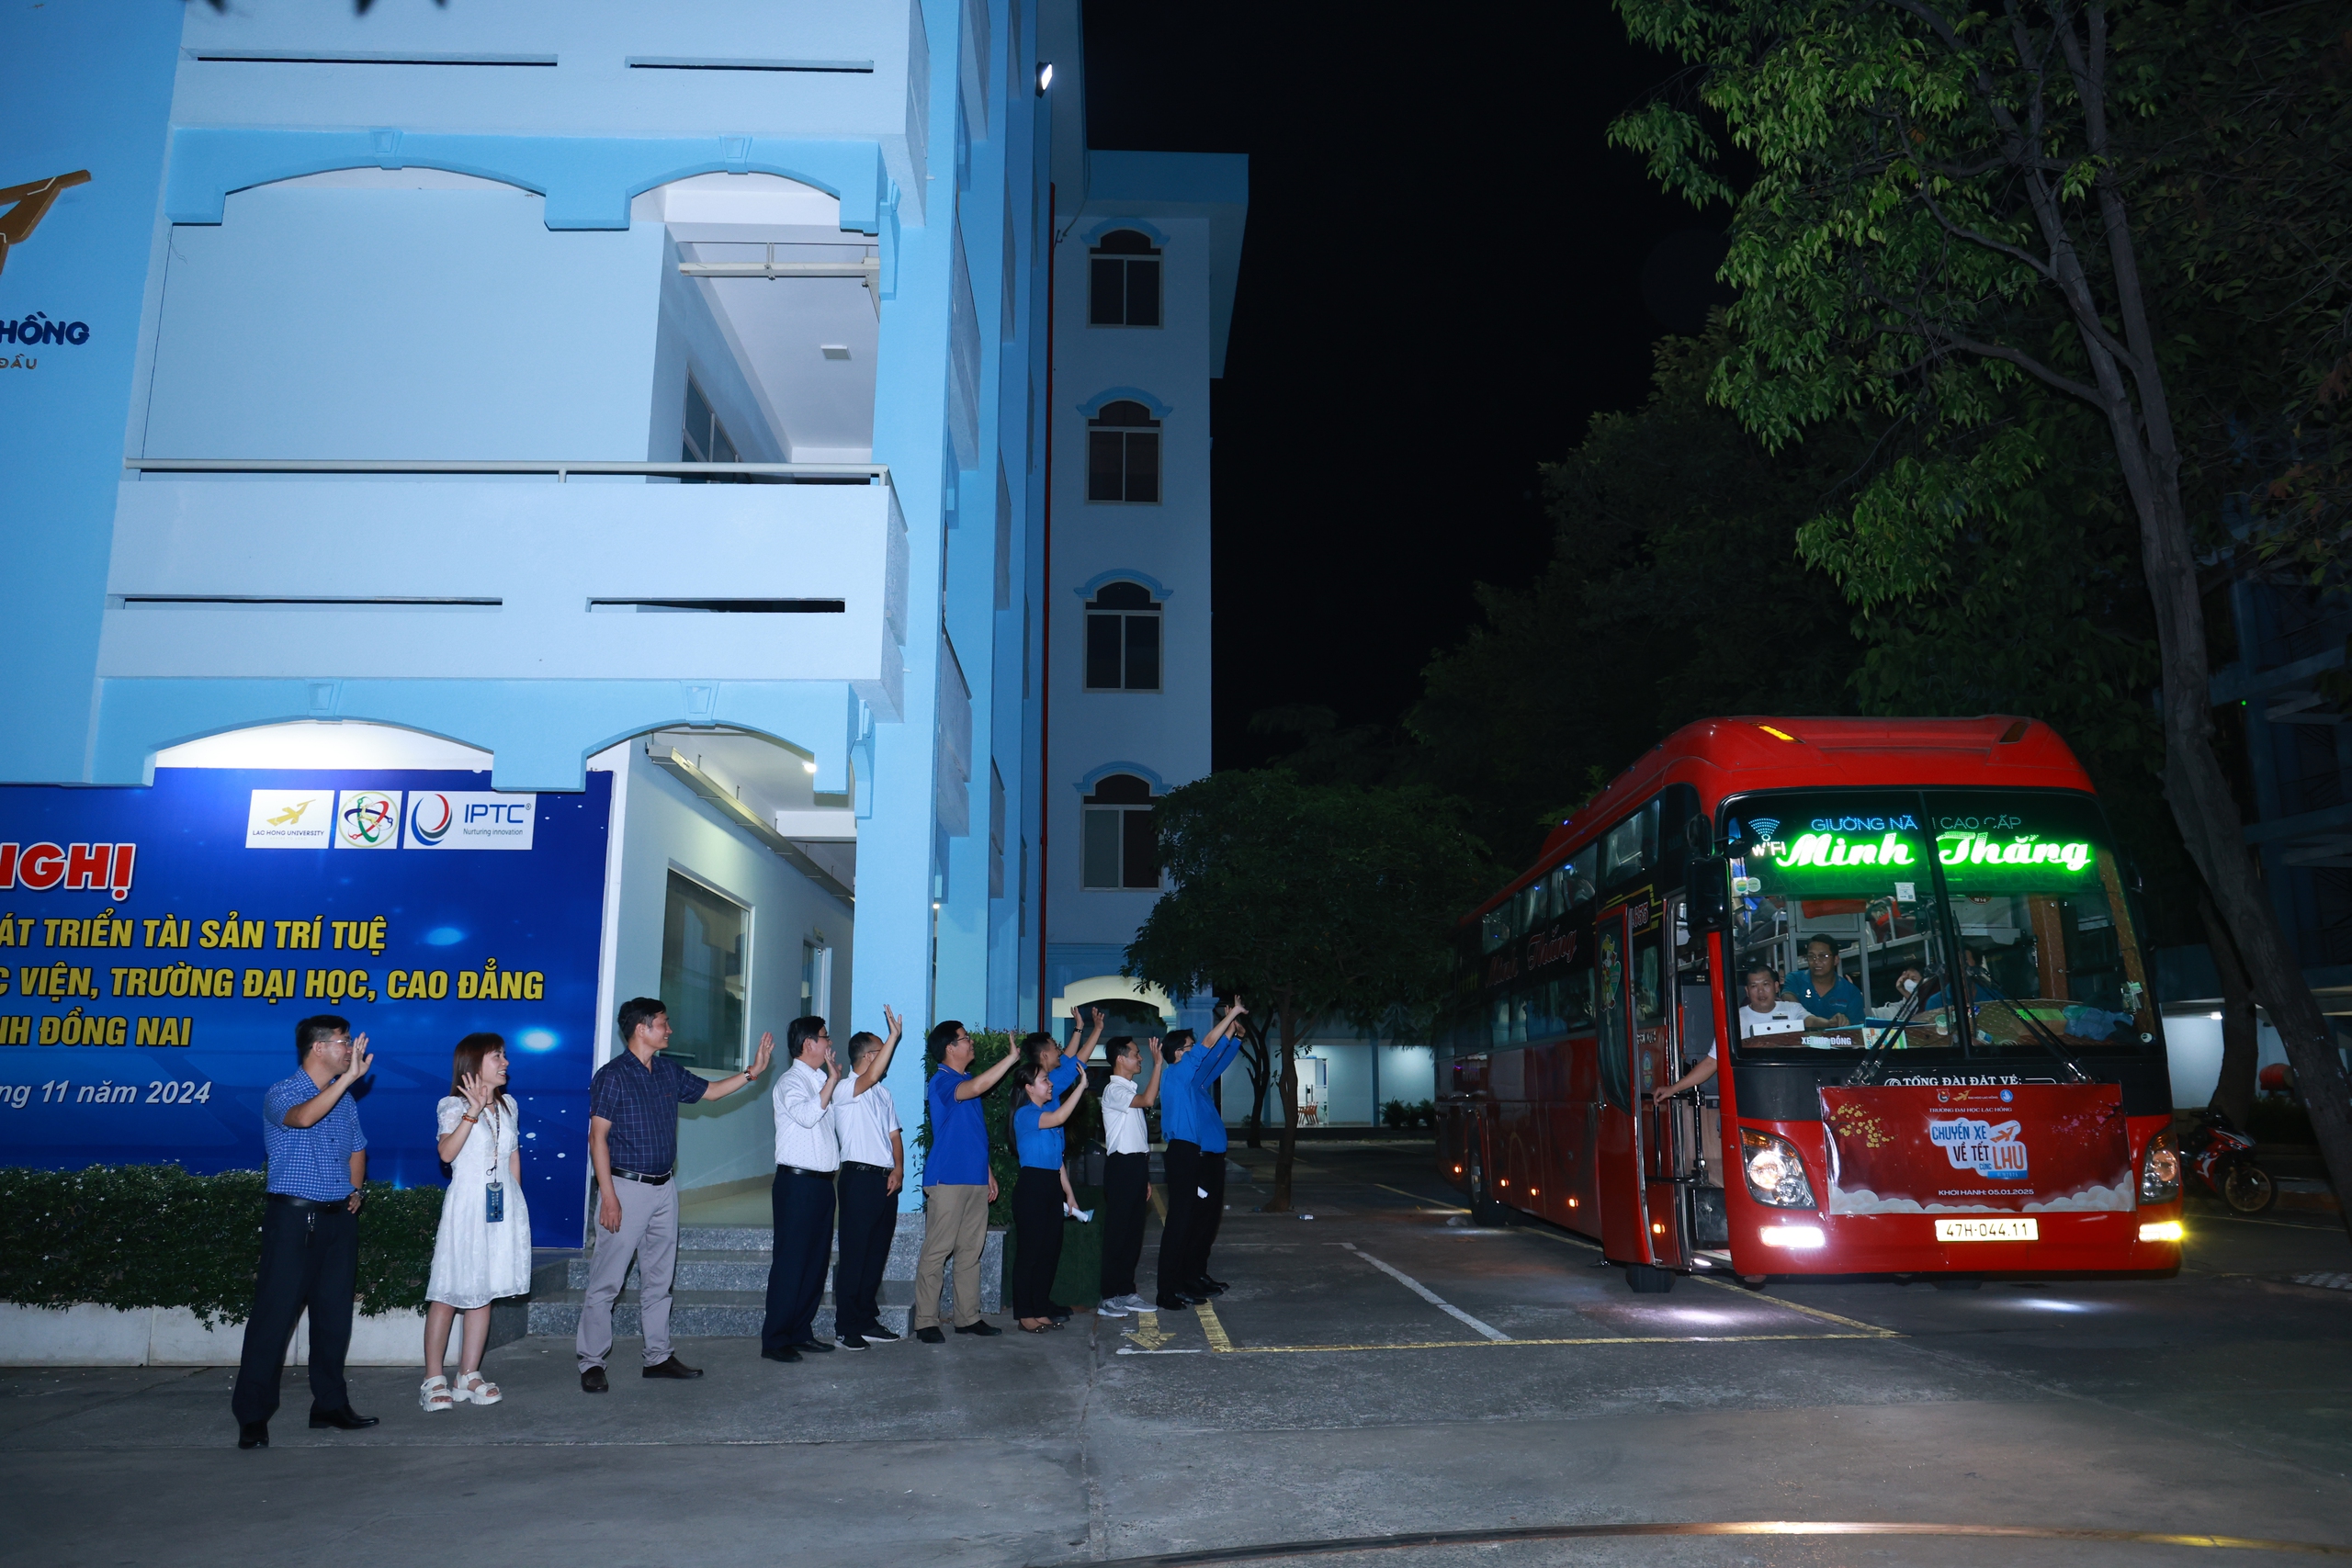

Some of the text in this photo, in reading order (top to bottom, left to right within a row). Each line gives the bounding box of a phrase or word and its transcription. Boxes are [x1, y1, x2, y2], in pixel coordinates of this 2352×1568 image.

[0, 310, 90, 345] HỒNG
[465, 804, 525, 823] IPTC
[1940, 817, 1979, 829] CAO
[463, 828, 524, 837] Nurturing innovation
[1776, 831, 2092, 872] Minh Thắng
[0, 907, 388, 956] ÁT TRIỂN TÀI SẢN TRÍ TUỆ
[20, 961, 99, 1002] VIỆN,
[110, 961, 234, 998] TRƯỜNG
[243, 968, 296, 1005] ĐẠI
[305, 968, 376, 1005] HỌC,
[387, 969, 448, 999] CAO
[458, 957, 545, 1000] ĐẲNG
[39, 1006, 128, 1046] ĐỒNG
[135, 1016, 193, 1047] NAI
[41, 1079, 70, 1103] 11
[76, 1079, 138, 1104] năm
[145, 1080, 212, 1104] 2024
[1931, 1122, 1987, 1140] CHUYẾN XE
[1952, 1141, 2024, 1170] VỀ TẾT LHU
